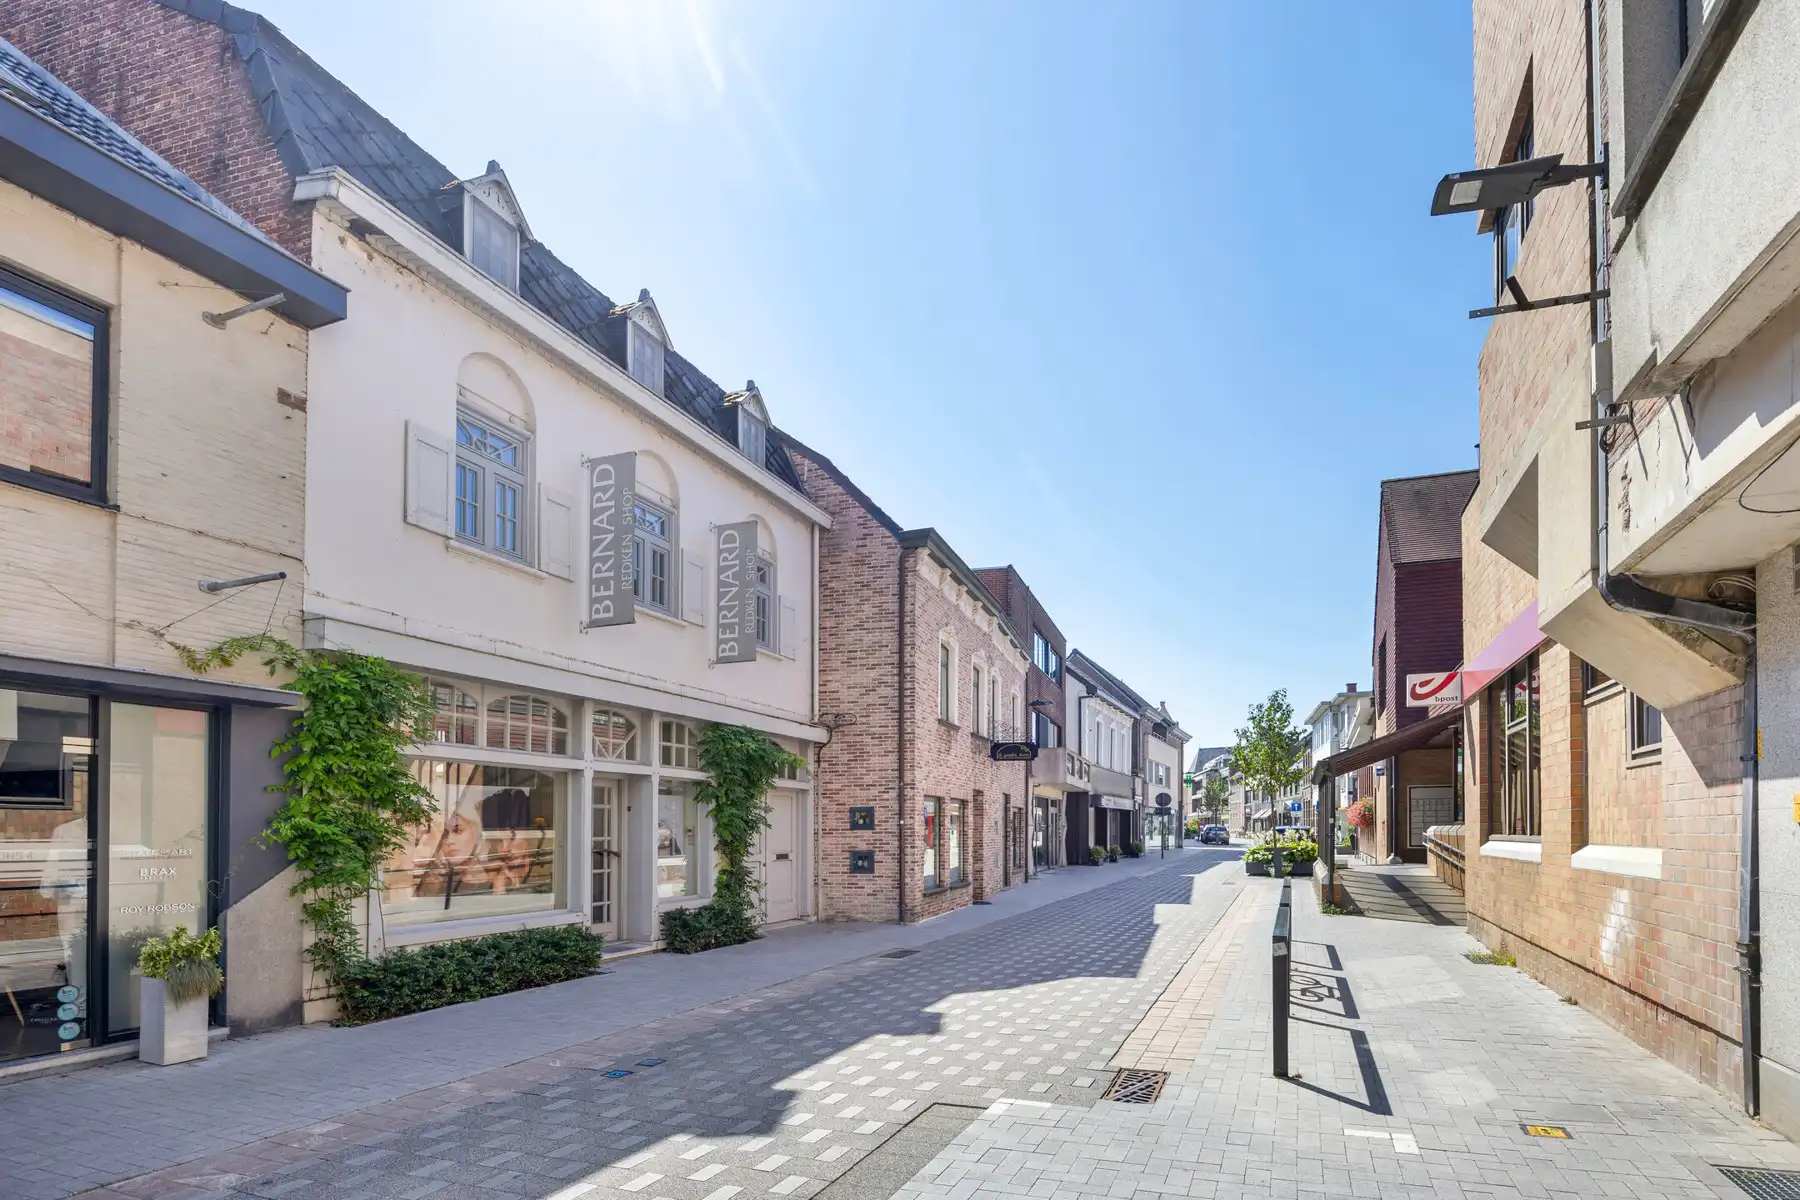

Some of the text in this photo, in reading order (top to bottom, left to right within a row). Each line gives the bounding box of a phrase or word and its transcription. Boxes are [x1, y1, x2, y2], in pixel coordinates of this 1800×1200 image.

[592, 463, 615, 620] BERNARD
[621, 487, 634, 590] REDKEN SHOP
[718, 530, 740, 657] BERNARD
[745, 549, 756, 634] REDKEN SHOP
[140, 867, 177, 876] BRAX
[171, 848, 193, 856] ART
[120, 902, 195, 914] ROY ROBSON
